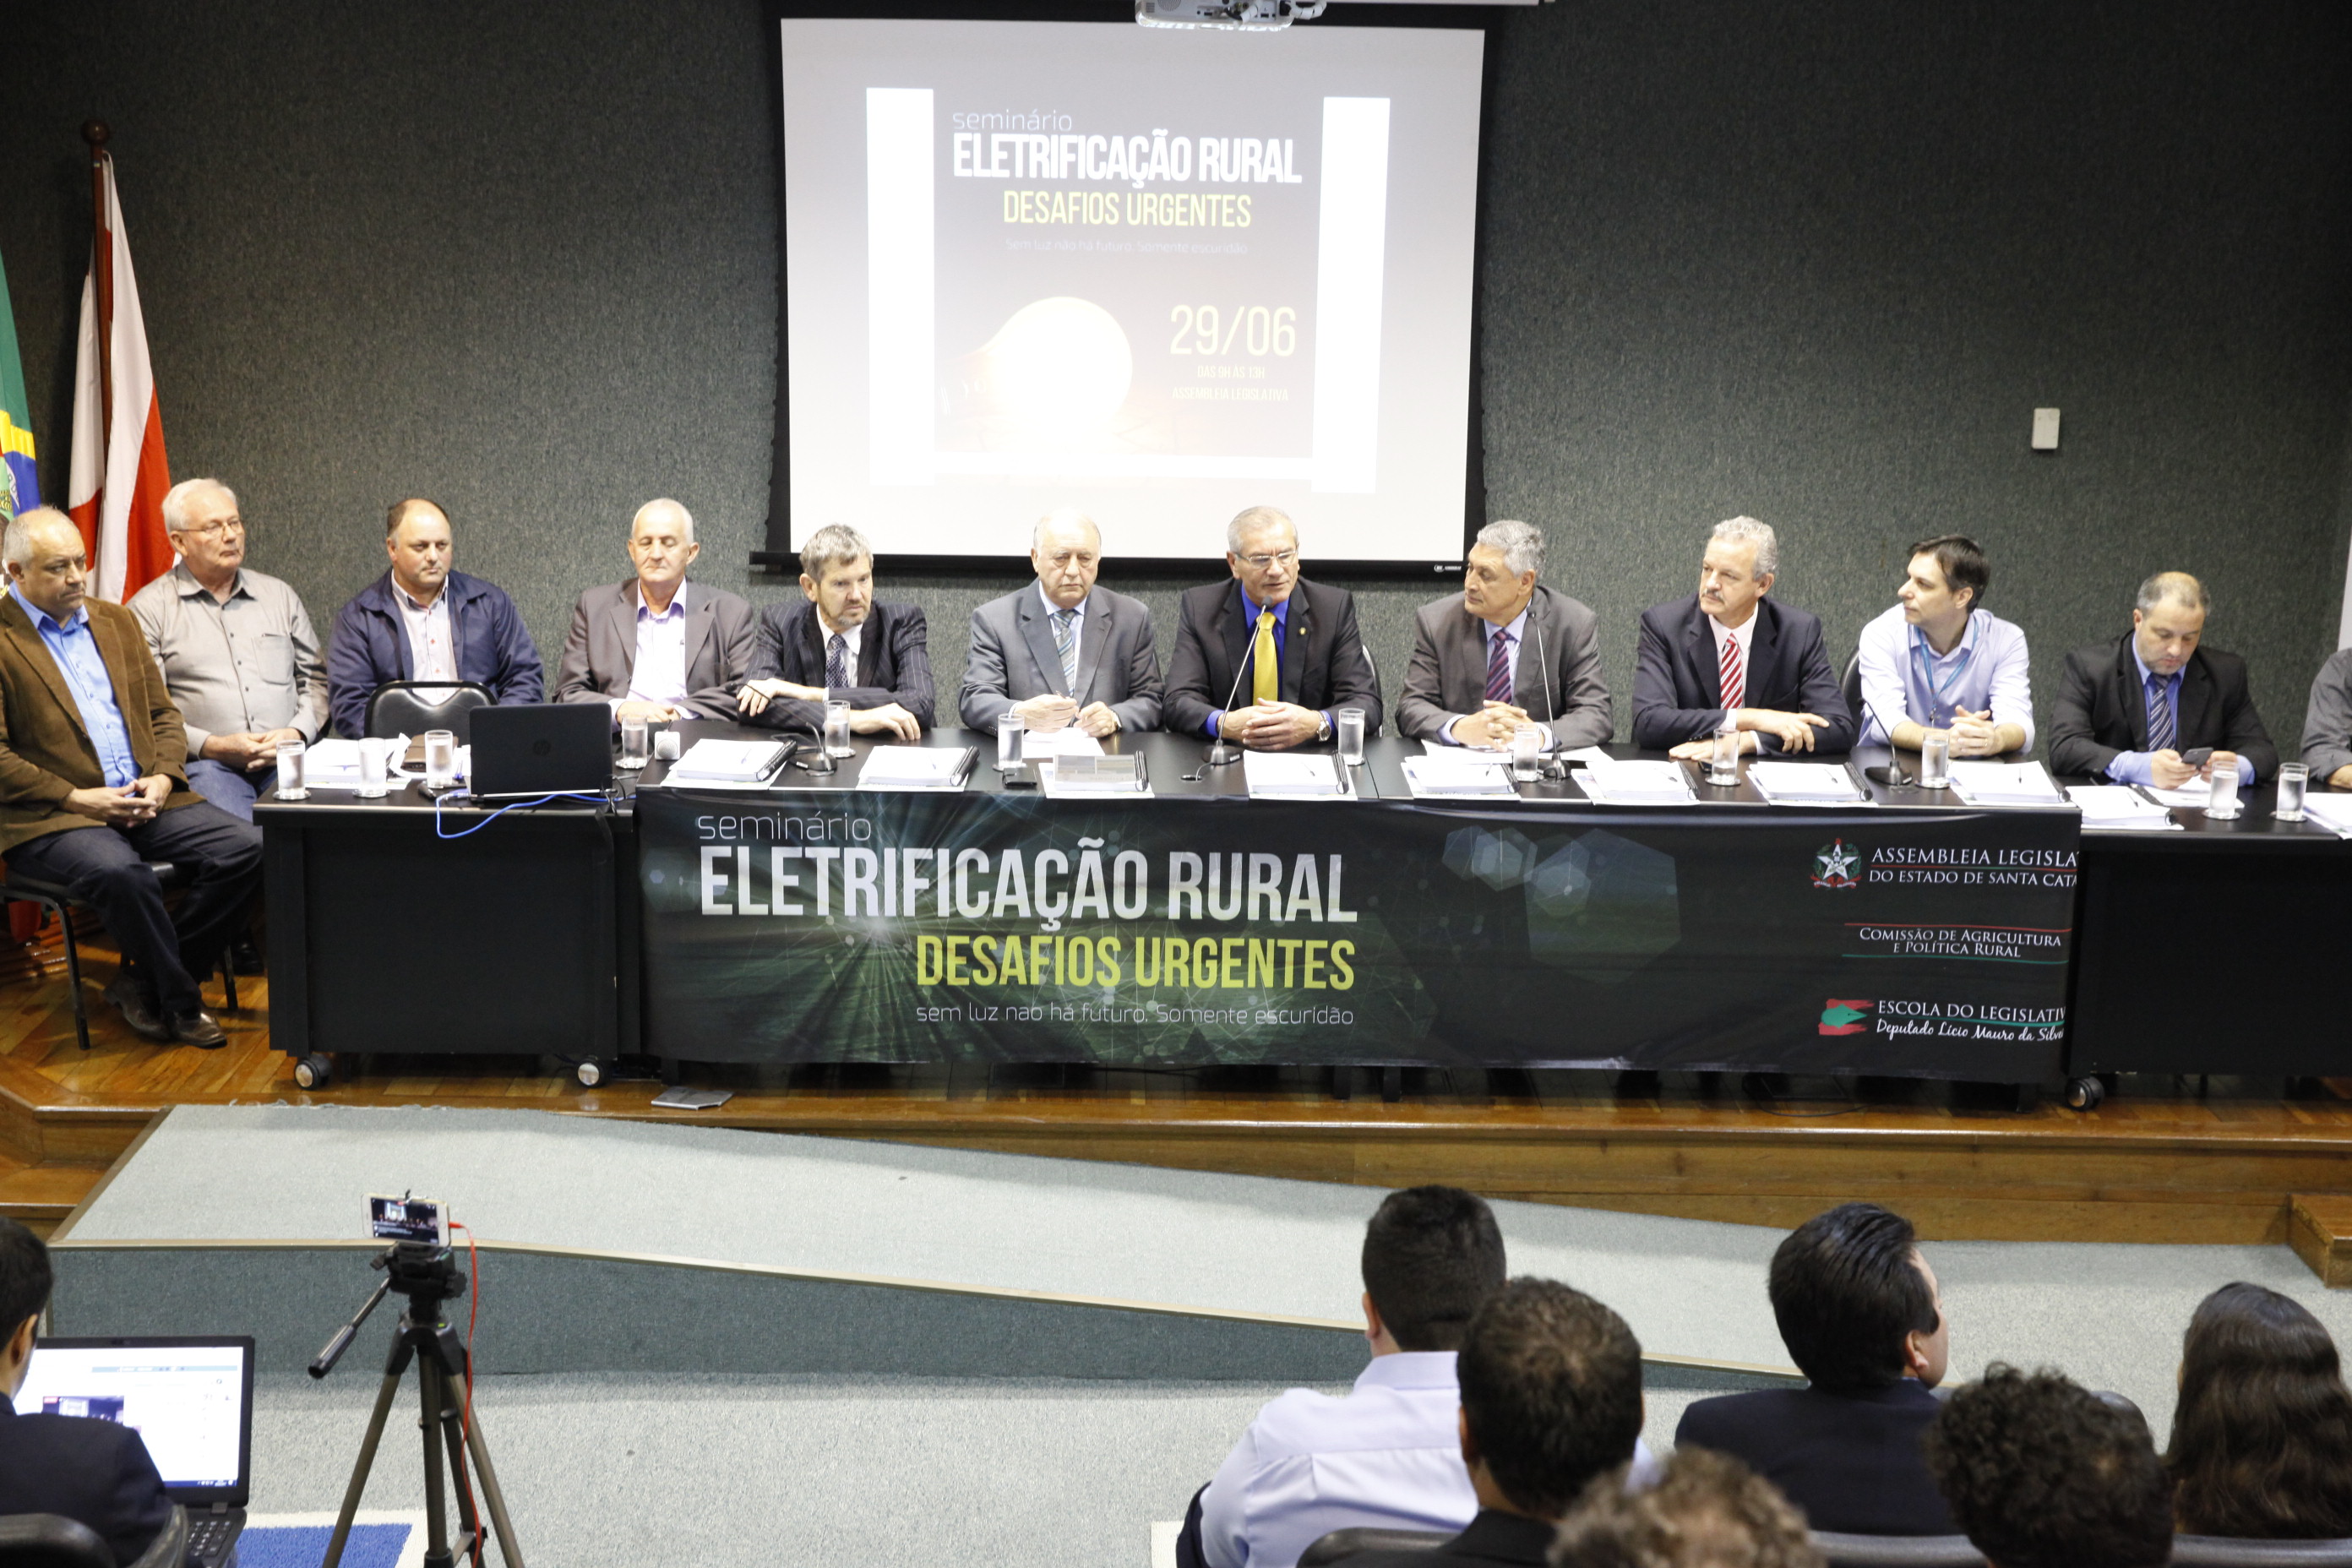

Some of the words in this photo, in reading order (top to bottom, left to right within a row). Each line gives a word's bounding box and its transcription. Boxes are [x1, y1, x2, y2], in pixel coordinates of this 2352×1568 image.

[953, 109, 1072, 132] seminário
[953, 128, 1192, 189] ELETRIFICAÇÃO
[1199, 137, 1303, 183] RURAL
[1004, 190, 1119, 225] DESAFIOS
[1126, 193, 1252, 227] URGENTES
[1170, 304, 1297, 357] 29/06
[1197, 365, 1217, 378] DAS
[1248, 366, 1266, 378] 13H
[1172, 387, 1229, 400] ASSEMBLEIA
[1231, 388, 1289, 401] LEGISLATIVA
[698, 811, 872, 841] seminário
[1871, 847, 1991, 864] ASSEMBLEIA
[1998, 849, 2079, 867] LEGISLA
[701, 836, 1148, 932] ELETRIFICAÇÃO
[1168, 851, 1358, 923] RURAL
[1870, 869, 1893, 883] DO
[1899, 870, 1958, 884] ESTADO
[1963, 871, 1984, 885] DE
[1989, 871, 2038, 885] SANTA
[917, 935, 1121, 987] DESAFIOS
[1135, 937, 1355, 990] URGENTES
[917, 1006, 961, 1021] sem
[969, 1002, 999, 1021] luz
[1050, 1001, 1074, 1021] há
[1082, 1002, 1148, 1023] futuro.
[1156, 1004, 1248, 1025] Somente
[1255, 1005, 1353, 1026] escuridão
[1878, 999, 1941, 1016] ESCOLA
[1946, 1003, 1974, 1018] DO
[1876, 1018, 1935, 1041] Deputado
[1971, 1025, 2015, 1041] Mauro
[2017, 1026, 2035, 1041] da
